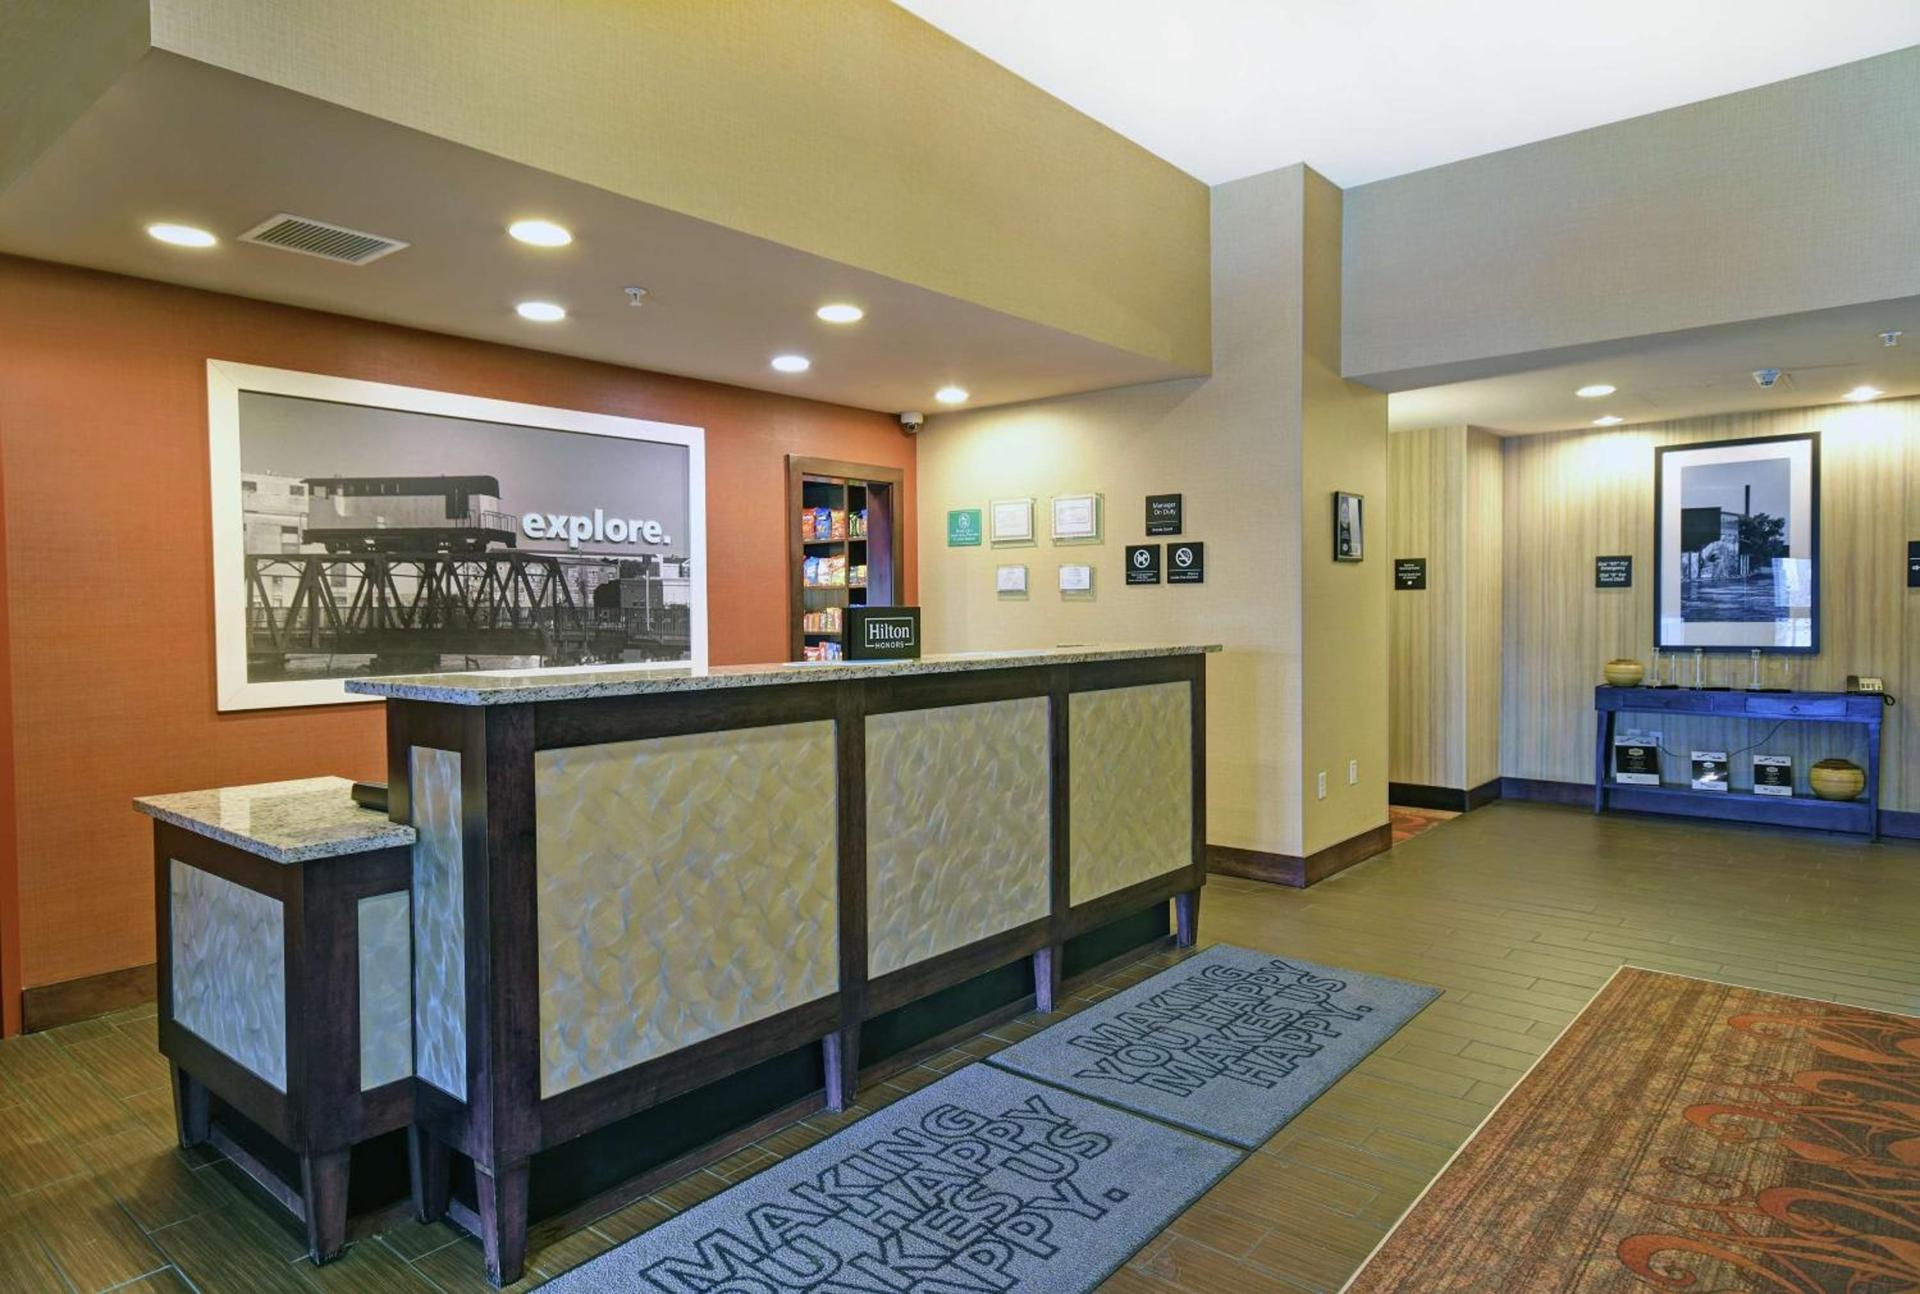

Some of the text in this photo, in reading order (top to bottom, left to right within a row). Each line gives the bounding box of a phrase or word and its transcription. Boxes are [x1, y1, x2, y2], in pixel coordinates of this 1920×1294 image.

[522, 508, 672, 549] explore.
[869, 623, 910, 640] Hilton
[875, 641, 905, 649] HONORS
[1066, 964, 1252, 1056] MAKING
[1072, 959, 1308, 1085] YOU HAPPY
[1136, 974, 1347, 1098] MAKES US
[1217, 1001, 1374, 1089] HAPPY.
[834, 1094, 1074, 1243] HAPPY
[999, 1123, 1113, 1183] US
[637, 1103, 994, 1294] MAKING
